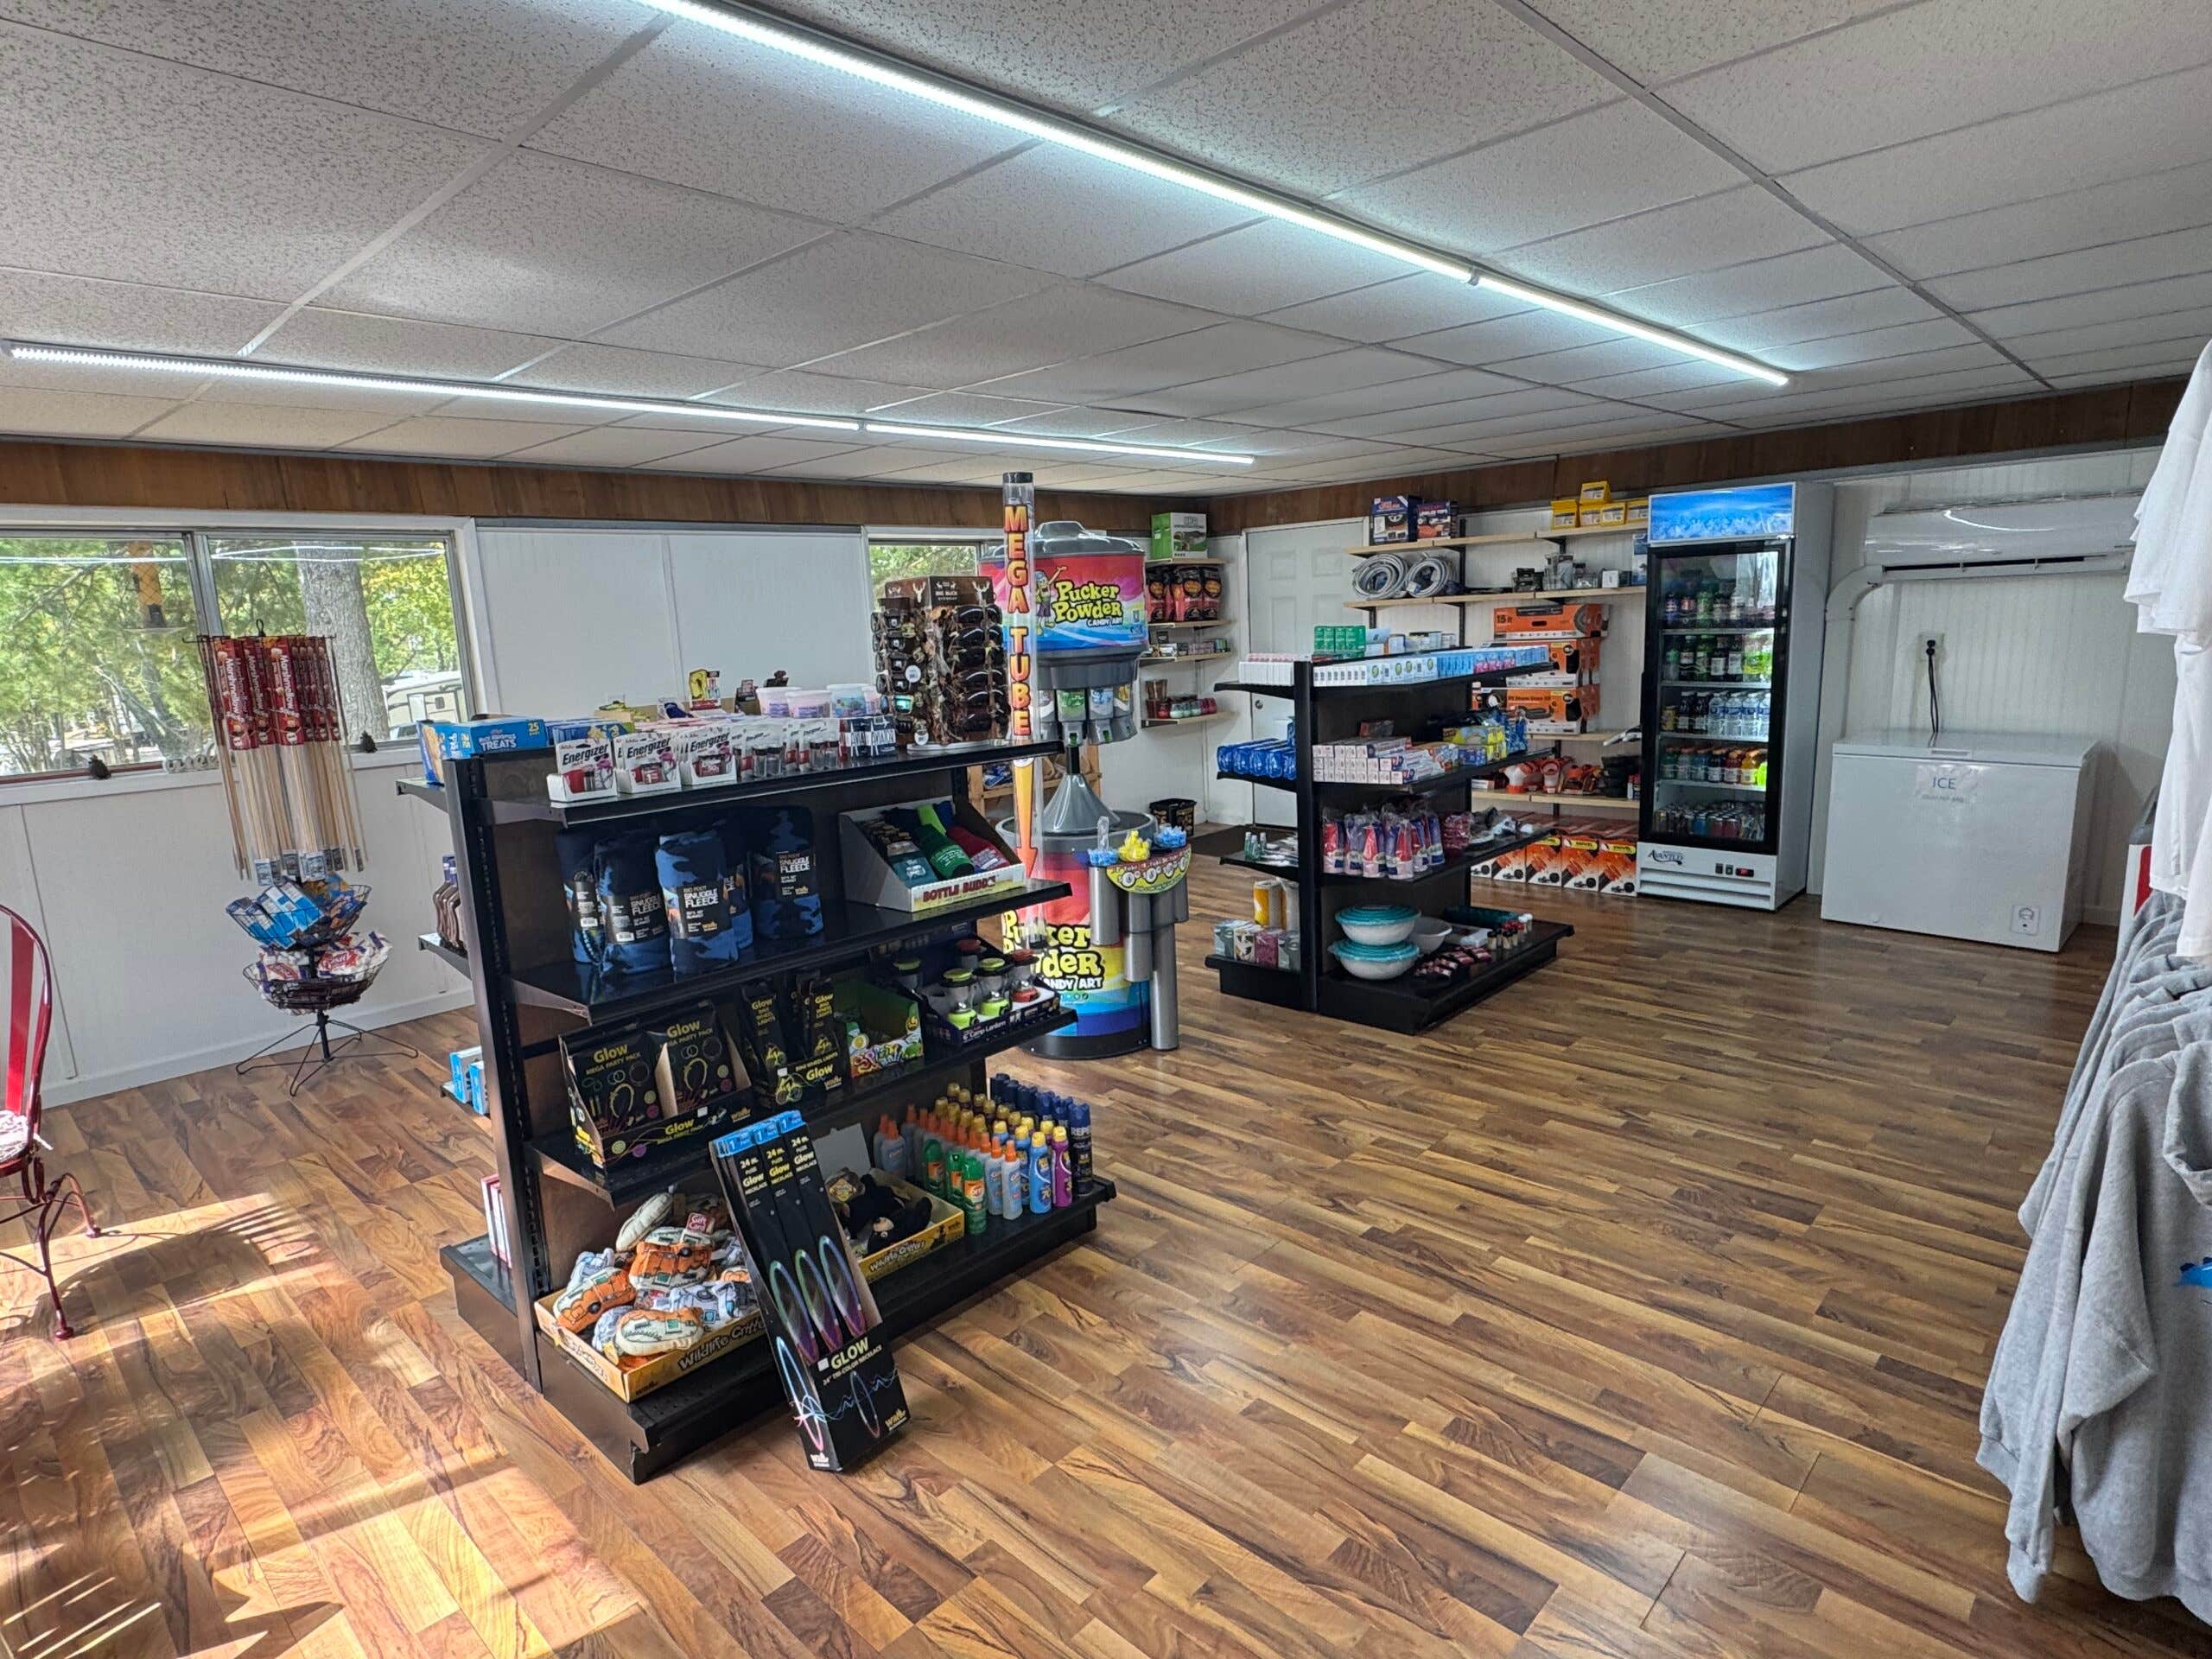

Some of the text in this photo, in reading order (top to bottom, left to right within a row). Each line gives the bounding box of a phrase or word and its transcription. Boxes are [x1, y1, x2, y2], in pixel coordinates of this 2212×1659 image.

[1054, 579, 1120, 603] Pucker
[1003, 505, 1032, 736] MEGA TUBE
[480, 739, 517, 752] TREATS
[626, 737, 671, 759] Energizer
[690, 732, 729, 753] Energizer
[562, 744, 609, 766] Energizer
[1932, 777, 1957, 790] ICE
[780, 863, 810, 874] FLEECE
[683, 888, 718, 900] SNUGGLE
[684, 894, 719, 908] FLEECE
[923, 884, 960, 903] BOTTLE
[632, 901, 662, 916] FLEECE
[1003, 910, 1091, 947] Puker
[1042, 976, 1103, 990] ANDY ART
[752, 998, 772, 1010] Glow
[815, 994, 834, 1004] Glow
[666, 1020, 700, 1039] Glow
[594, 1044, 628, 1064] Glow
[806, 1064, 834, 1081] Glow
[664, 1119, 695, 1135] Glow
[791, 1137, 802, 1147] 24
[766, 1148, 776, 1159] 24
[794, 1151, 815, 1165] Glow
[740, 1158, 750, 1169] 24
[769, 1163, 790, 1177] Glow
[742, 1173, 764, 1187] Glow
[678, 1334, 729, 1371] Wildlife
[830, 1337, 868, 1370] GLOW
[858, 1344, 882, 1363] NECKLACE
